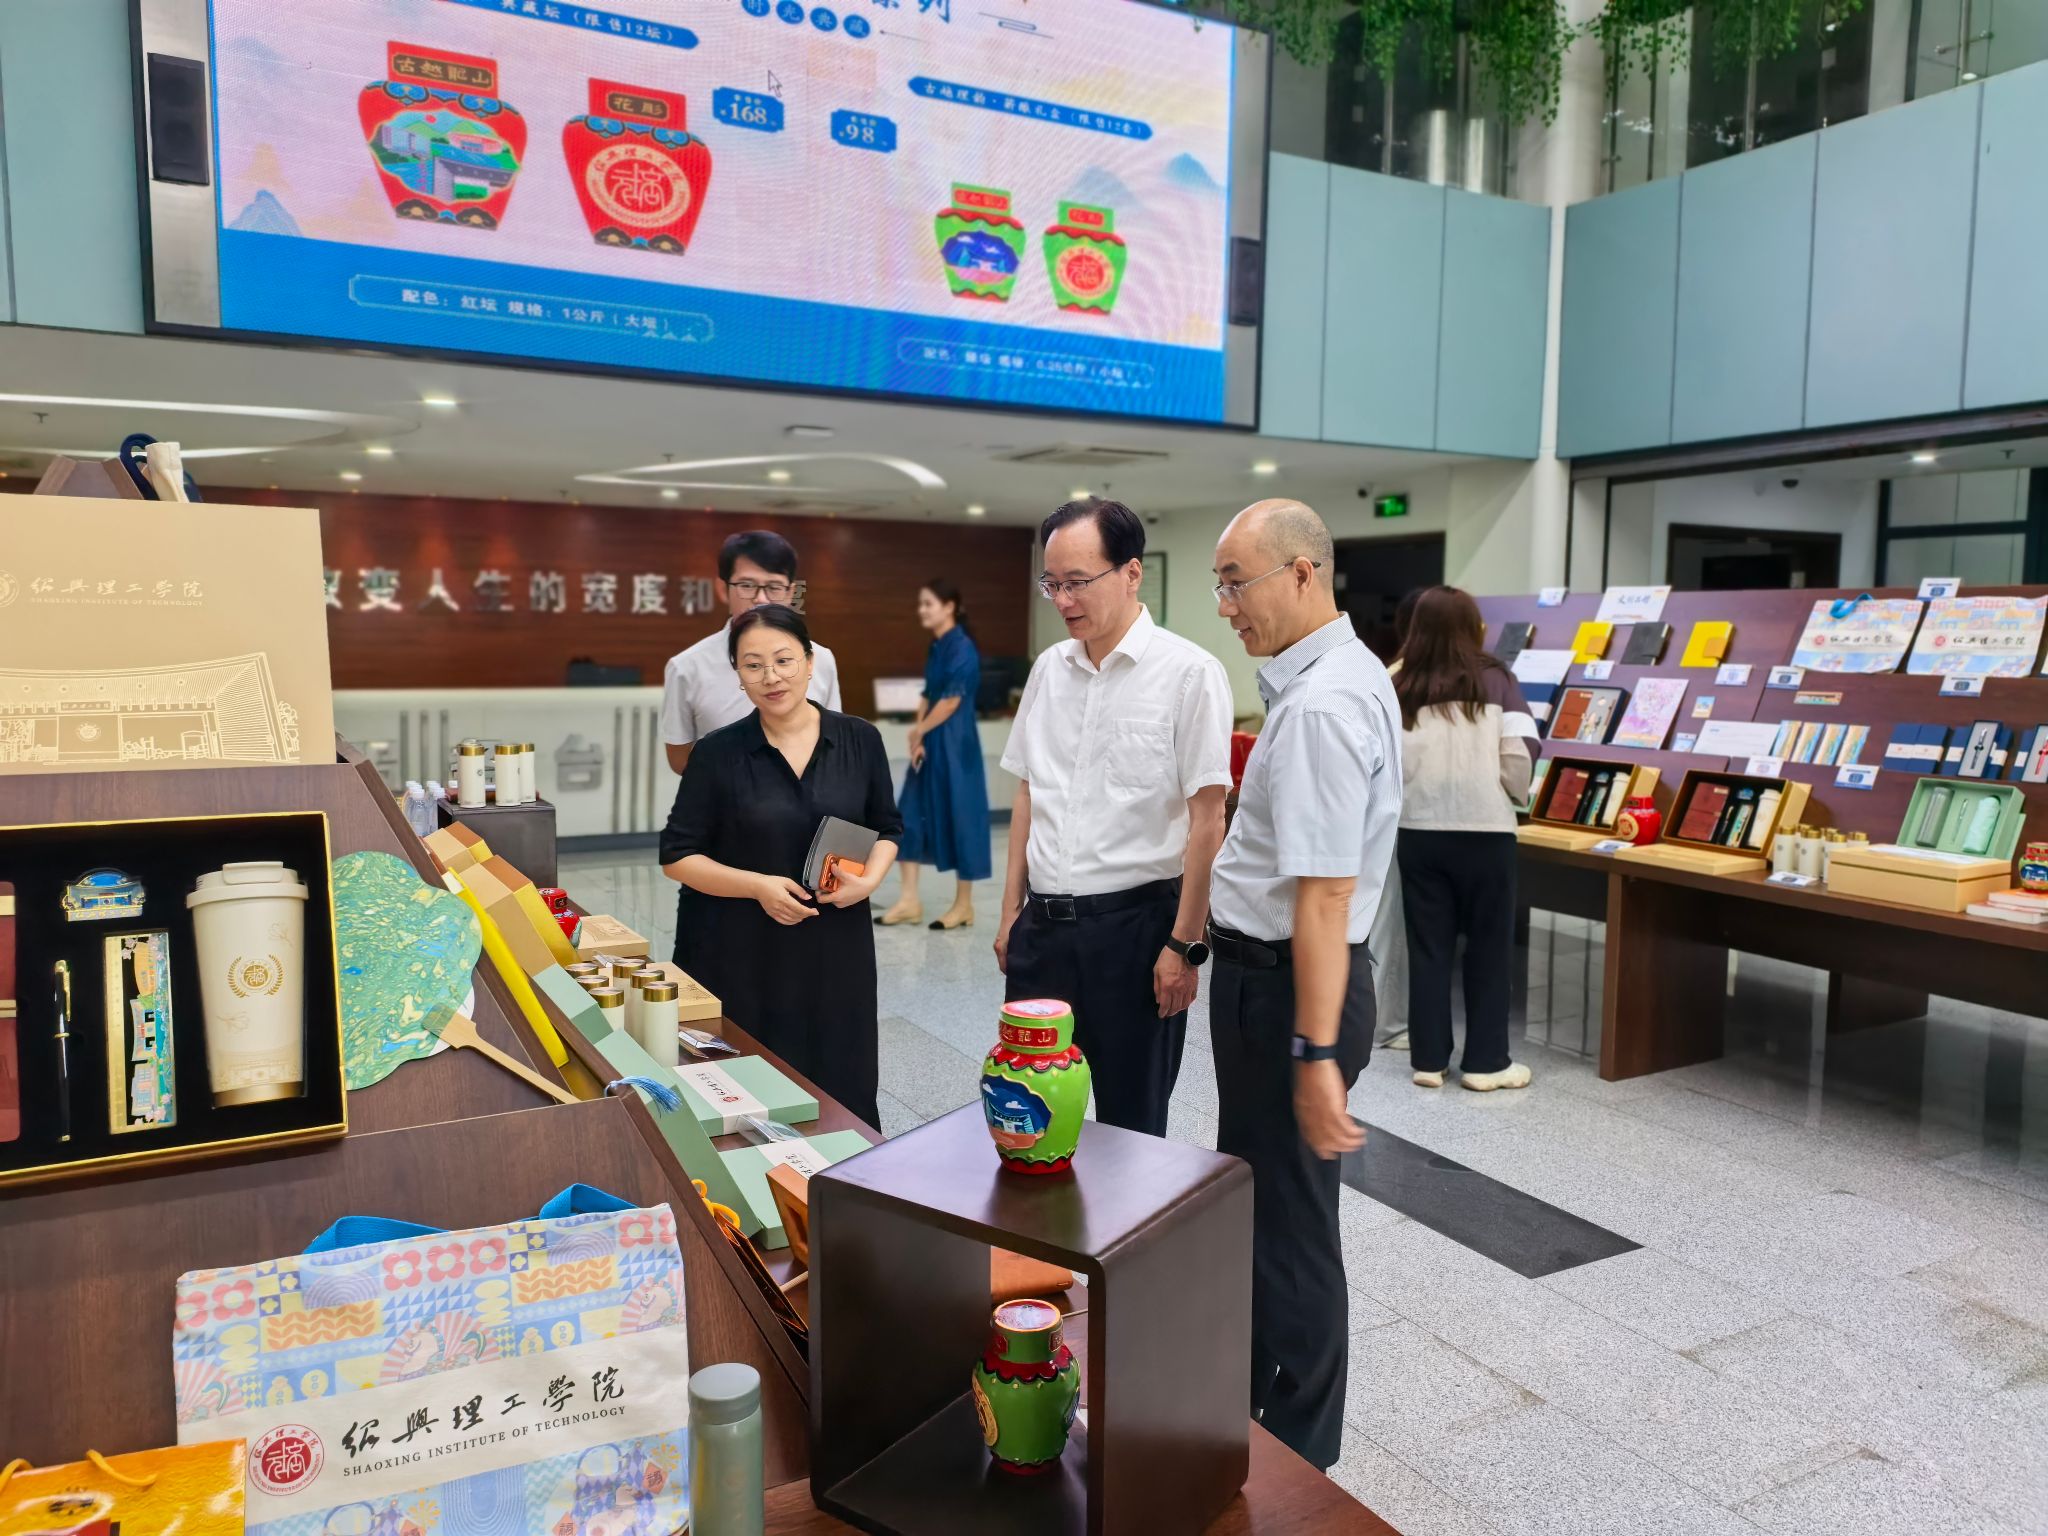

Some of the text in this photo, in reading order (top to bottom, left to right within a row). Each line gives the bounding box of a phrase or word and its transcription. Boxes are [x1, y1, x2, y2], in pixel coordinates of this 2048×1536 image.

[729, 102, 768, 125] 168
[845, 124, 875, 144] 98
[324, 567, 806, 615] 变人生的宽度和
[343, 1451, 422, 1477] SHAOXING
[428, 1431, 506, 1458] INSTITUTE
[512, 1426, 530, 1438] OF
[535, 1405, 627, 1432] TECHNOLOGY
